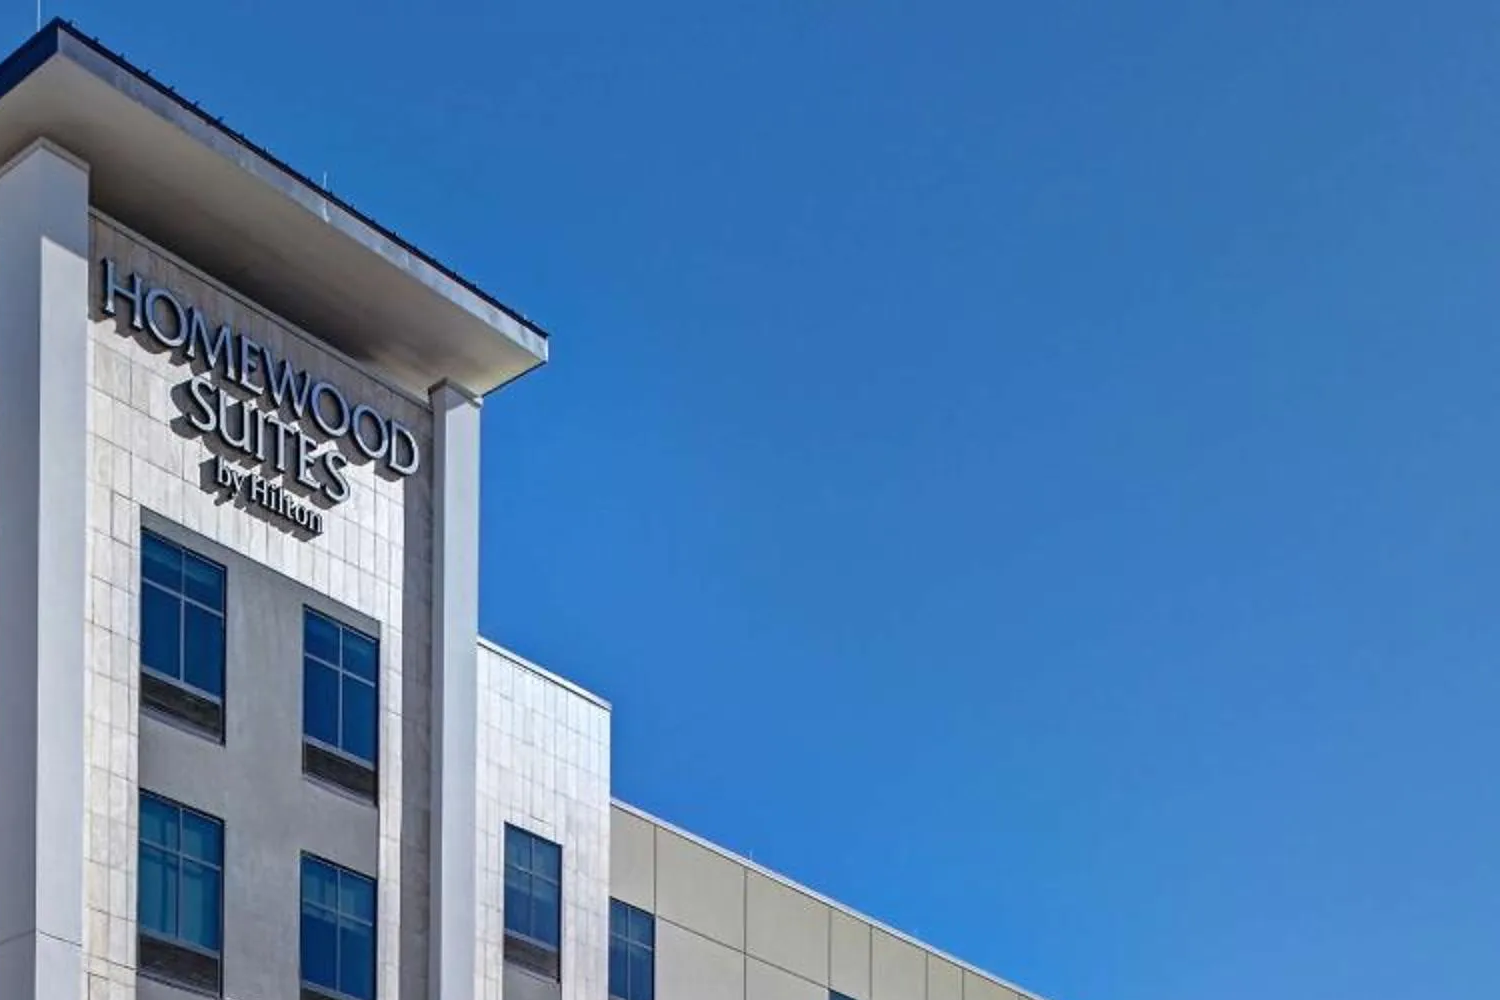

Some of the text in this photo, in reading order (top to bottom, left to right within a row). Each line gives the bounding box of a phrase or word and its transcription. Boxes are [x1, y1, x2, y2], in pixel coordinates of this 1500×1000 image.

[101, 257, 419, 476] HOMEWOOD
[187, 374, 350, 502] SUITES
[217, 454, 324, 534] by Hilton
